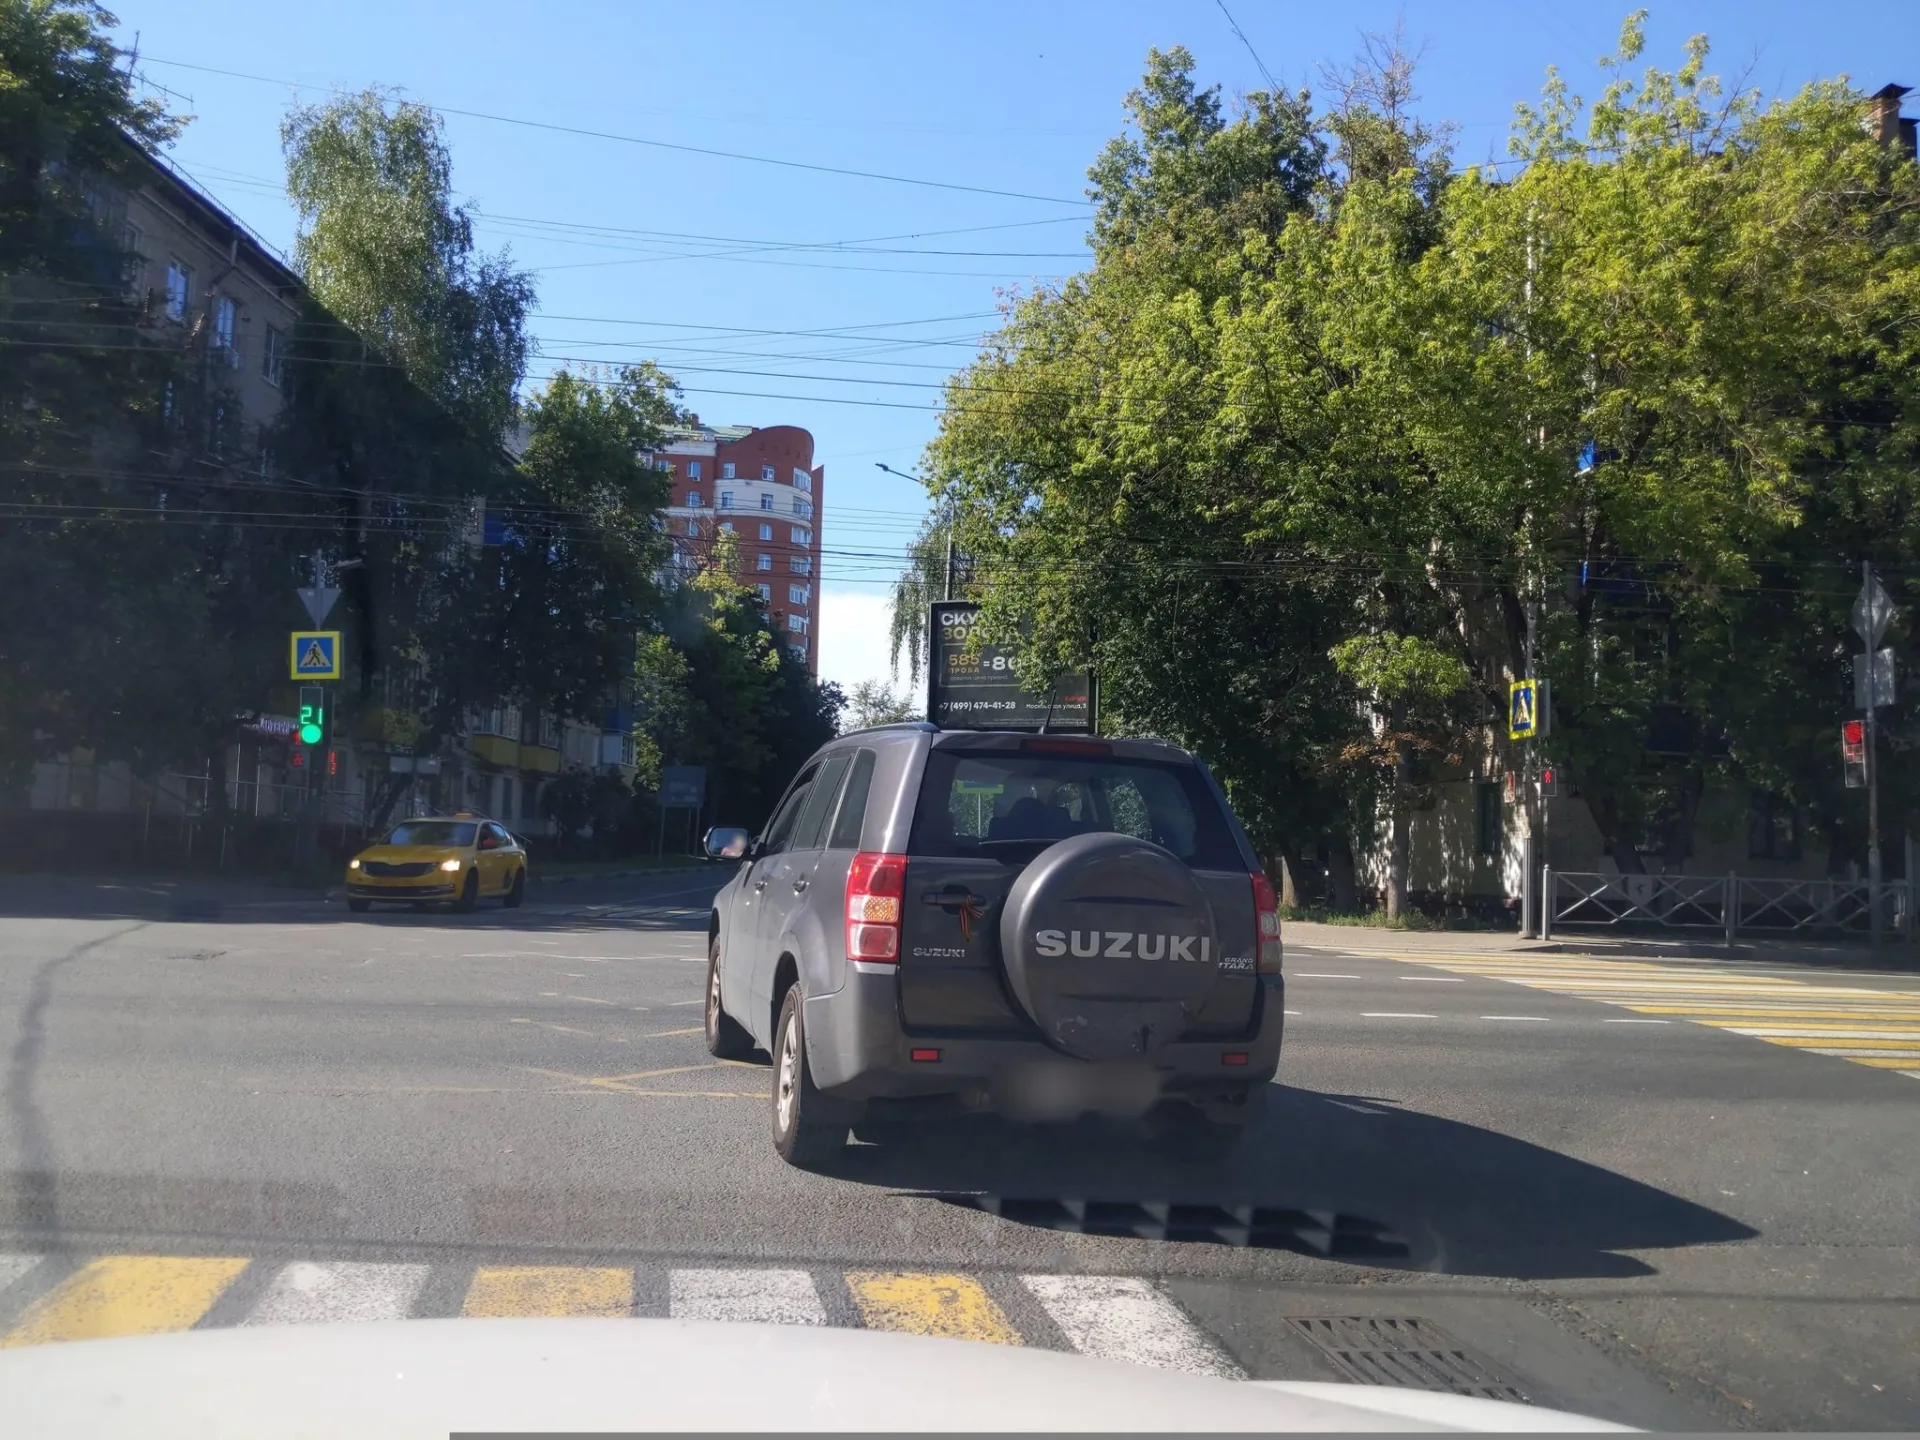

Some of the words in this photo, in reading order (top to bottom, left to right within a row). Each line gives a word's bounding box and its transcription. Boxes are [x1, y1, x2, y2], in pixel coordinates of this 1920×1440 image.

[938, 702, 949, 710] +7
[950, 701, 972, 712] (499)
[973, 701, 1016, 710] 474-41-28
[301, 706, 323, 725] 21
[1035, 929, 1211, 962] SUZUKI
[912, 947, 966, 958] SUZUKI
[1218, 962, 1254, 970] ITARA
